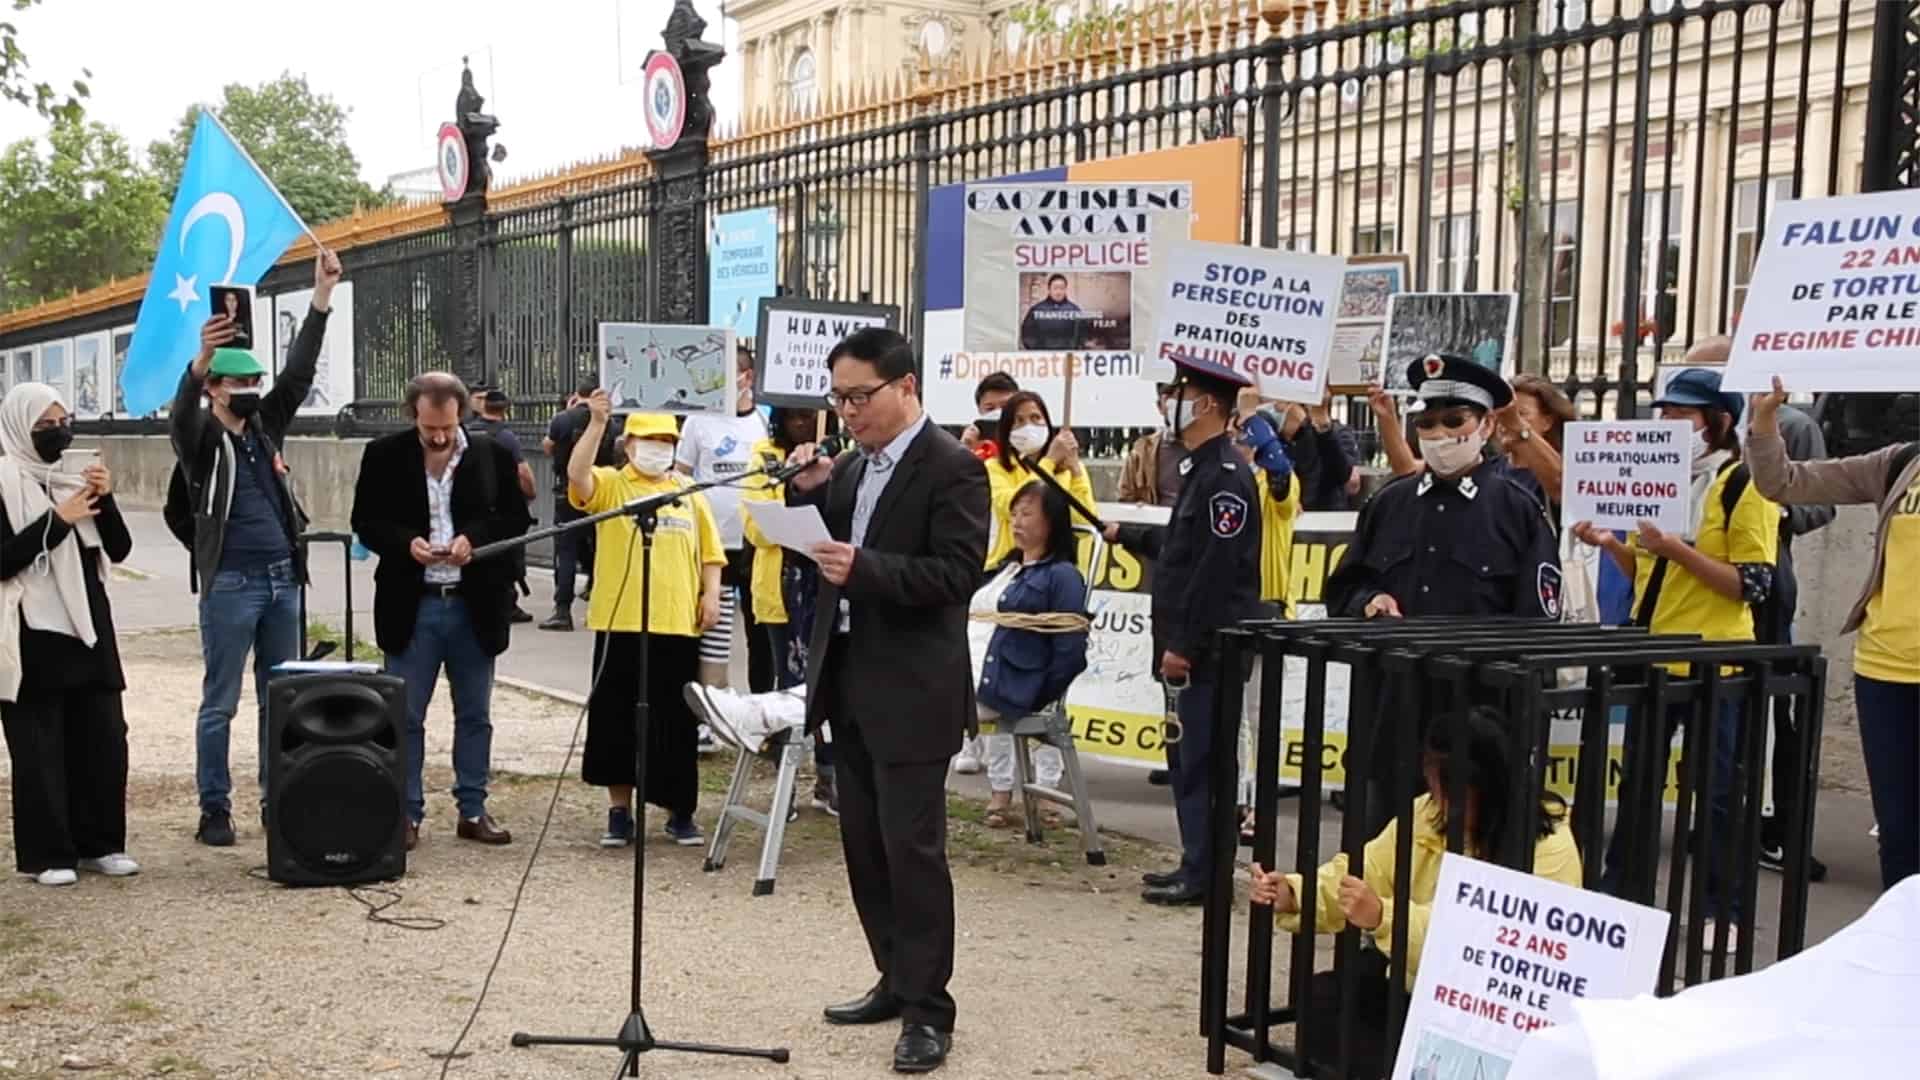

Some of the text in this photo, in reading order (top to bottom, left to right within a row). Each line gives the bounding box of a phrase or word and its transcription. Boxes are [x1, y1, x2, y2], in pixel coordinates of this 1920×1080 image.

[1014, 214, 1149, 235] AVOCAT
[1782, 214, 1902, 247] FALUN
[1015, 237, 1149, 267] SUPPLICIÉ
[1840, 246, 1920, 270] 22 AN
[1205, 263, 1311, 294] STOP A LA
[1792, 274, 1920, 301] DE TORTU
[1171, 282, 1324, 317] PERSECUTION
[1826, 301, 1917, 322] PAR LE
[1225, 310, 1260, 328] DES
[1174, 323, 1307, 355] PRATIQUANTS
[1752, 327, 1920, 351] REGIME CHI
[1243, 354, 1314, 382] GONG
[819, 375, 828, 391] P
[1584, 431, 1672, 443] LE PCC MENT
[1575, 452, 1680, 465] LES PRATIQUANTS
[1619, 467, 1632, 477] DE
[1577, 481, 1677, 498] FALUN GONG
[1596, 502, 1660, 517] MEURENT
[1456, 882, 1626, 949] FALUN GONG
[1496, 926, 1568, 961] 22 ANS
[1463, 946, 1587, 998] DE TORTURE
[1434, 984, 1509, 1024] REGIME
[1486, 978, 1550, 1011] PAR LE
